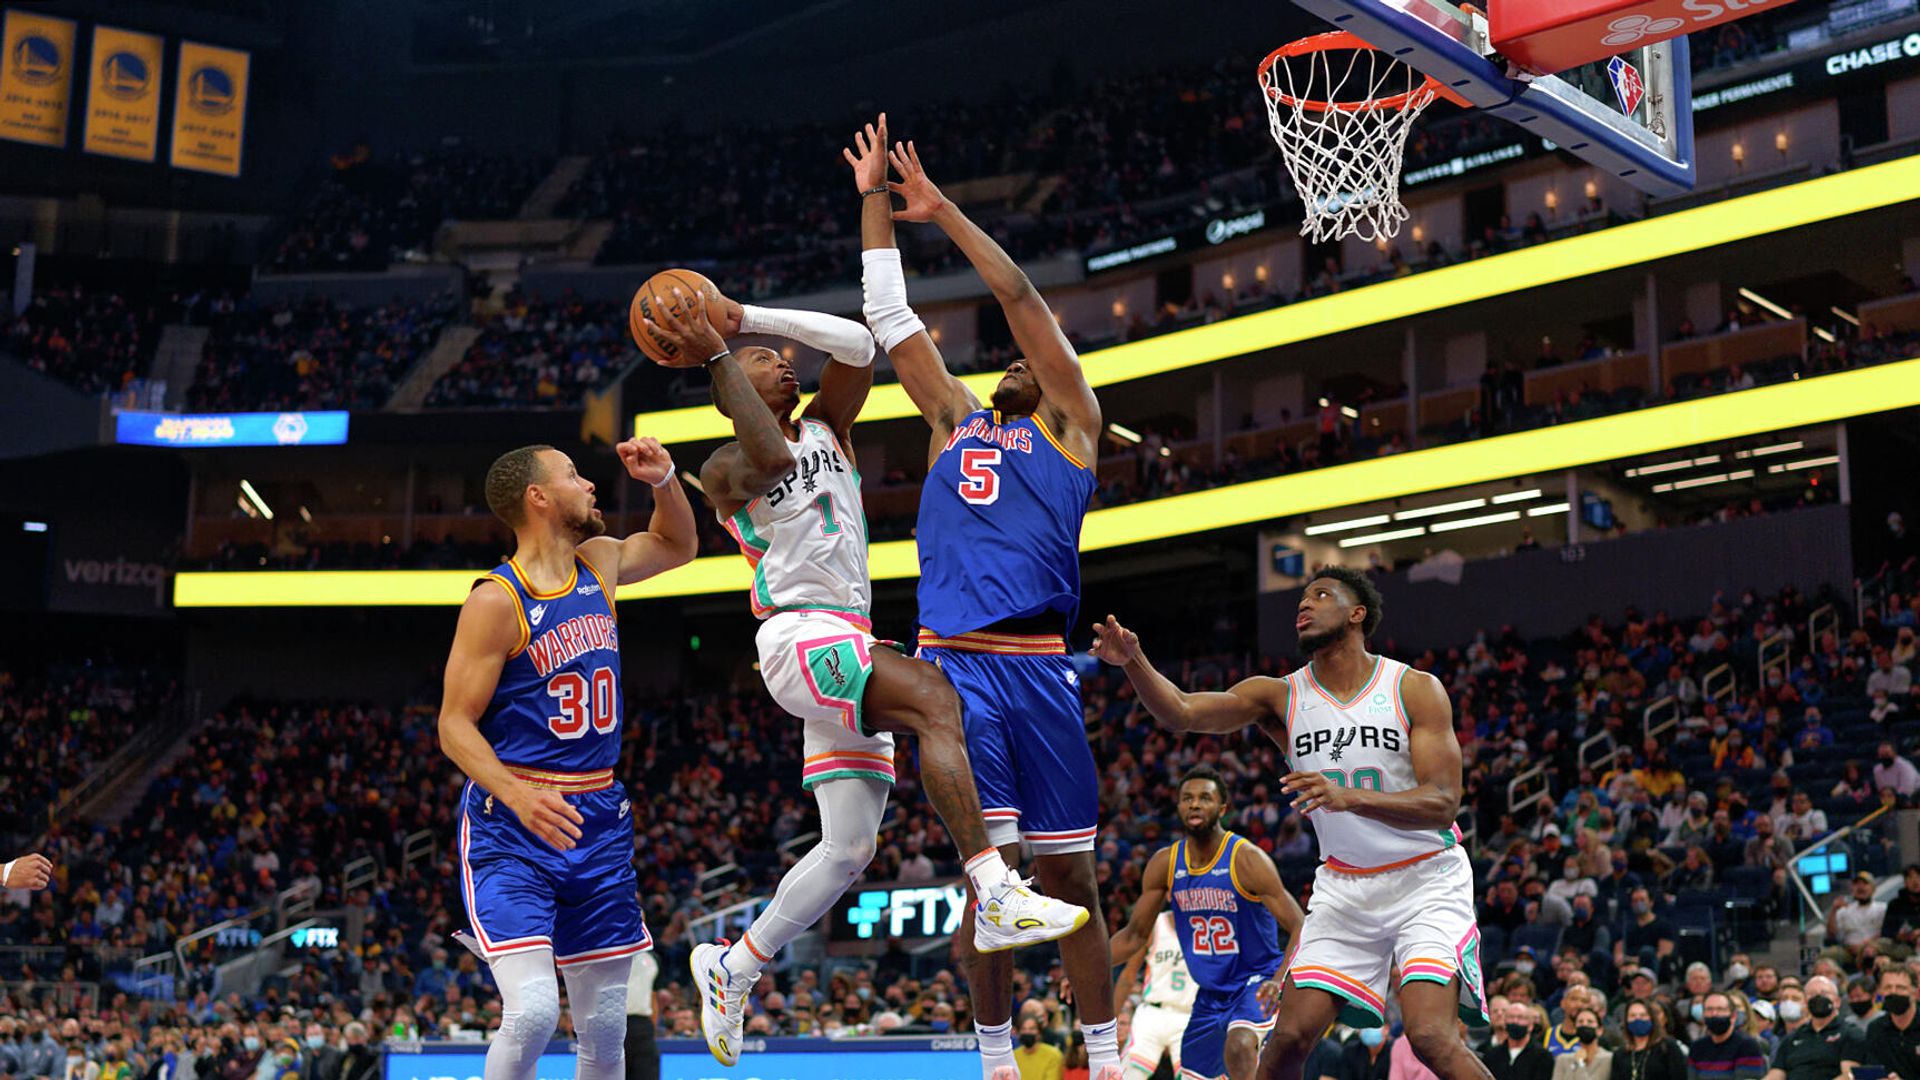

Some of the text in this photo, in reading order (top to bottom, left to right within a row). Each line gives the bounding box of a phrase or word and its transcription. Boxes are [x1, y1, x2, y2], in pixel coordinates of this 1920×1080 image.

[1826, 40, 1902, 76] CHASE
[1404, 143, 1524, 185] UNITED AIRLINES
[1225, 210, 1265, 238] pepsi
[766, 449, 844, 508] SPURS
[958, 448, 1002, 506] 5
[813, 491, 843, 537] 1
[64, 556, 160, 586] verizo
[527, 614, 618, 677] WARRIORS
[547, 666, 618, 740] 30
[1295, 726, 1400, 763] SPURS
[889, 887, 967, 937] FTX
[1174, 887, 1238, 912] WARRIORS
[306, 927, 339, 947] FTX
[1189, 916, 1240, 956] 22
[1171, 970, 1186, 991] 5
